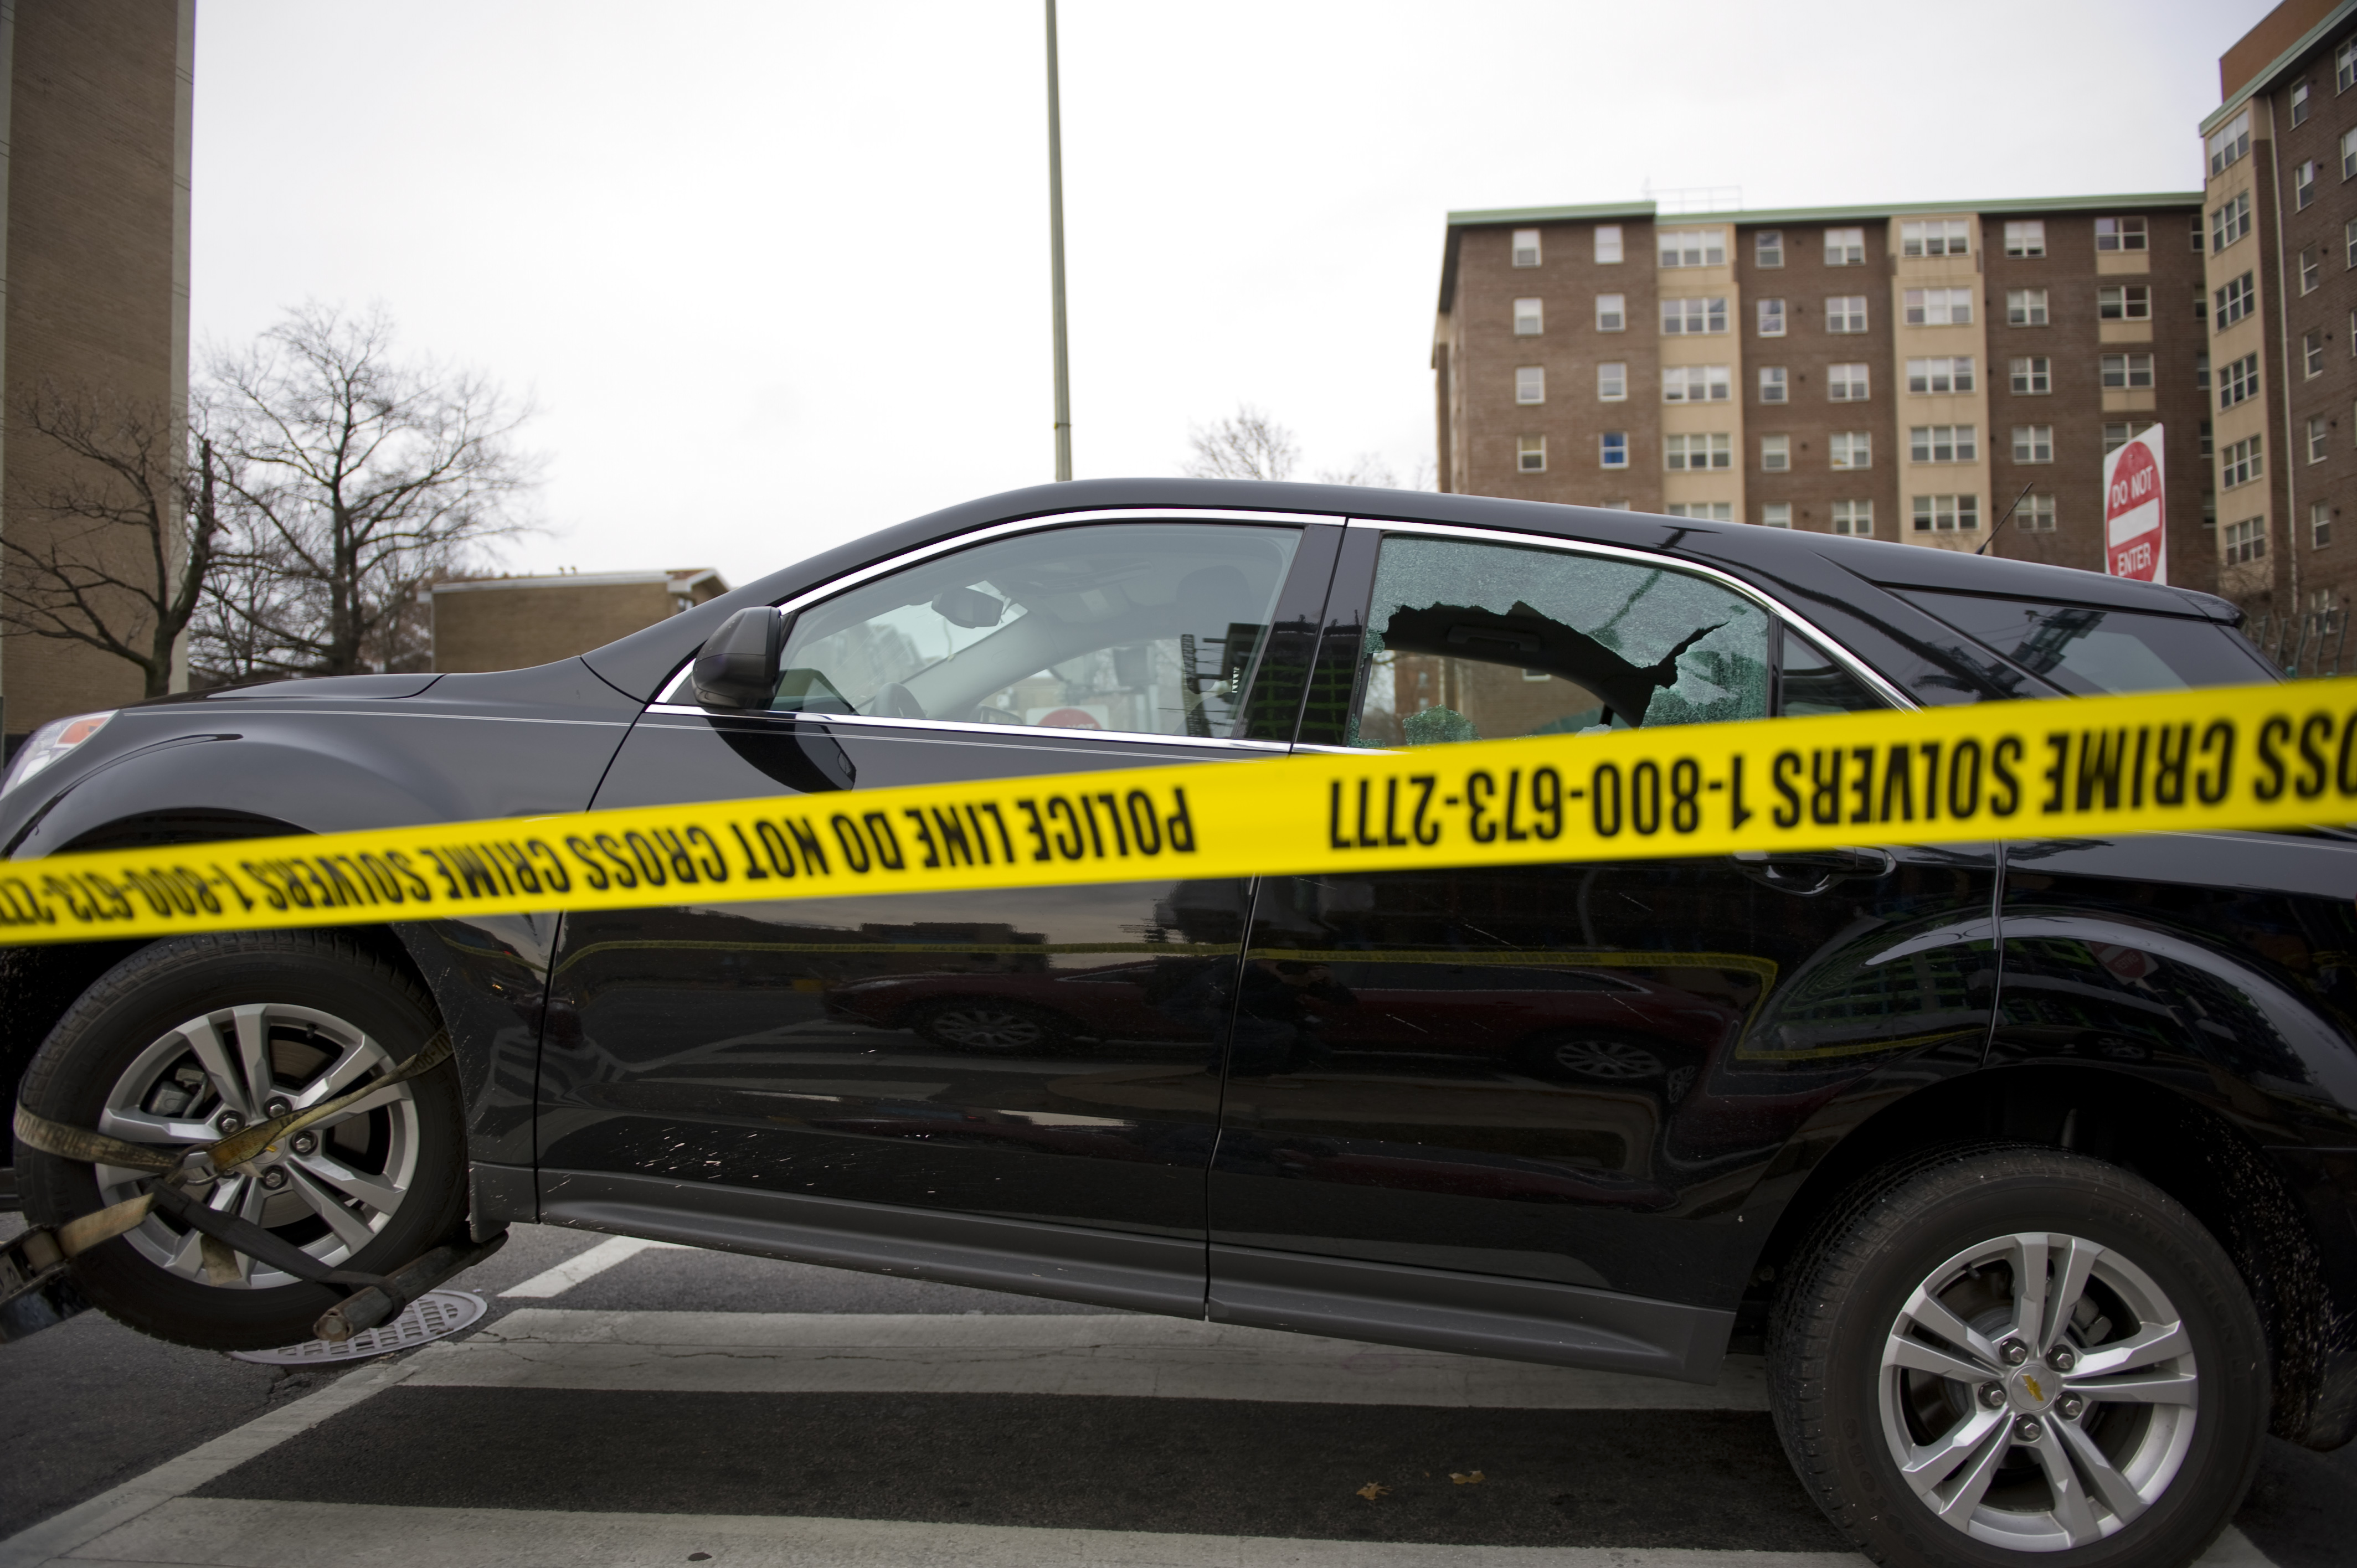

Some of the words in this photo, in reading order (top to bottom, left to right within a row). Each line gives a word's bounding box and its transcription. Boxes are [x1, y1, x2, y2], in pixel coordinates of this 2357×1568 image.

[2112, 479, 2128, 509] DO
[2131, 465, 2154, 499] NOT
[2117, 542, 2152, 577] ENTER
[1772, 734, 2024, 830] SOLVERS
[2042, 717, 2238, 814] CRIME
[1016, 786, 1197, 862] POLICE
[1330, 754, 1753, 849] 1-800-673-2777
[564, 826, 729, 891] CROSS
[730, 816, 831, 880] NOT
[830, 812, 906, 874] DO
[904, 802, 1015, 868] LINE
[238, 850, 431, 911] SOLVERS
[418, 838, 571, 900] CRIME
